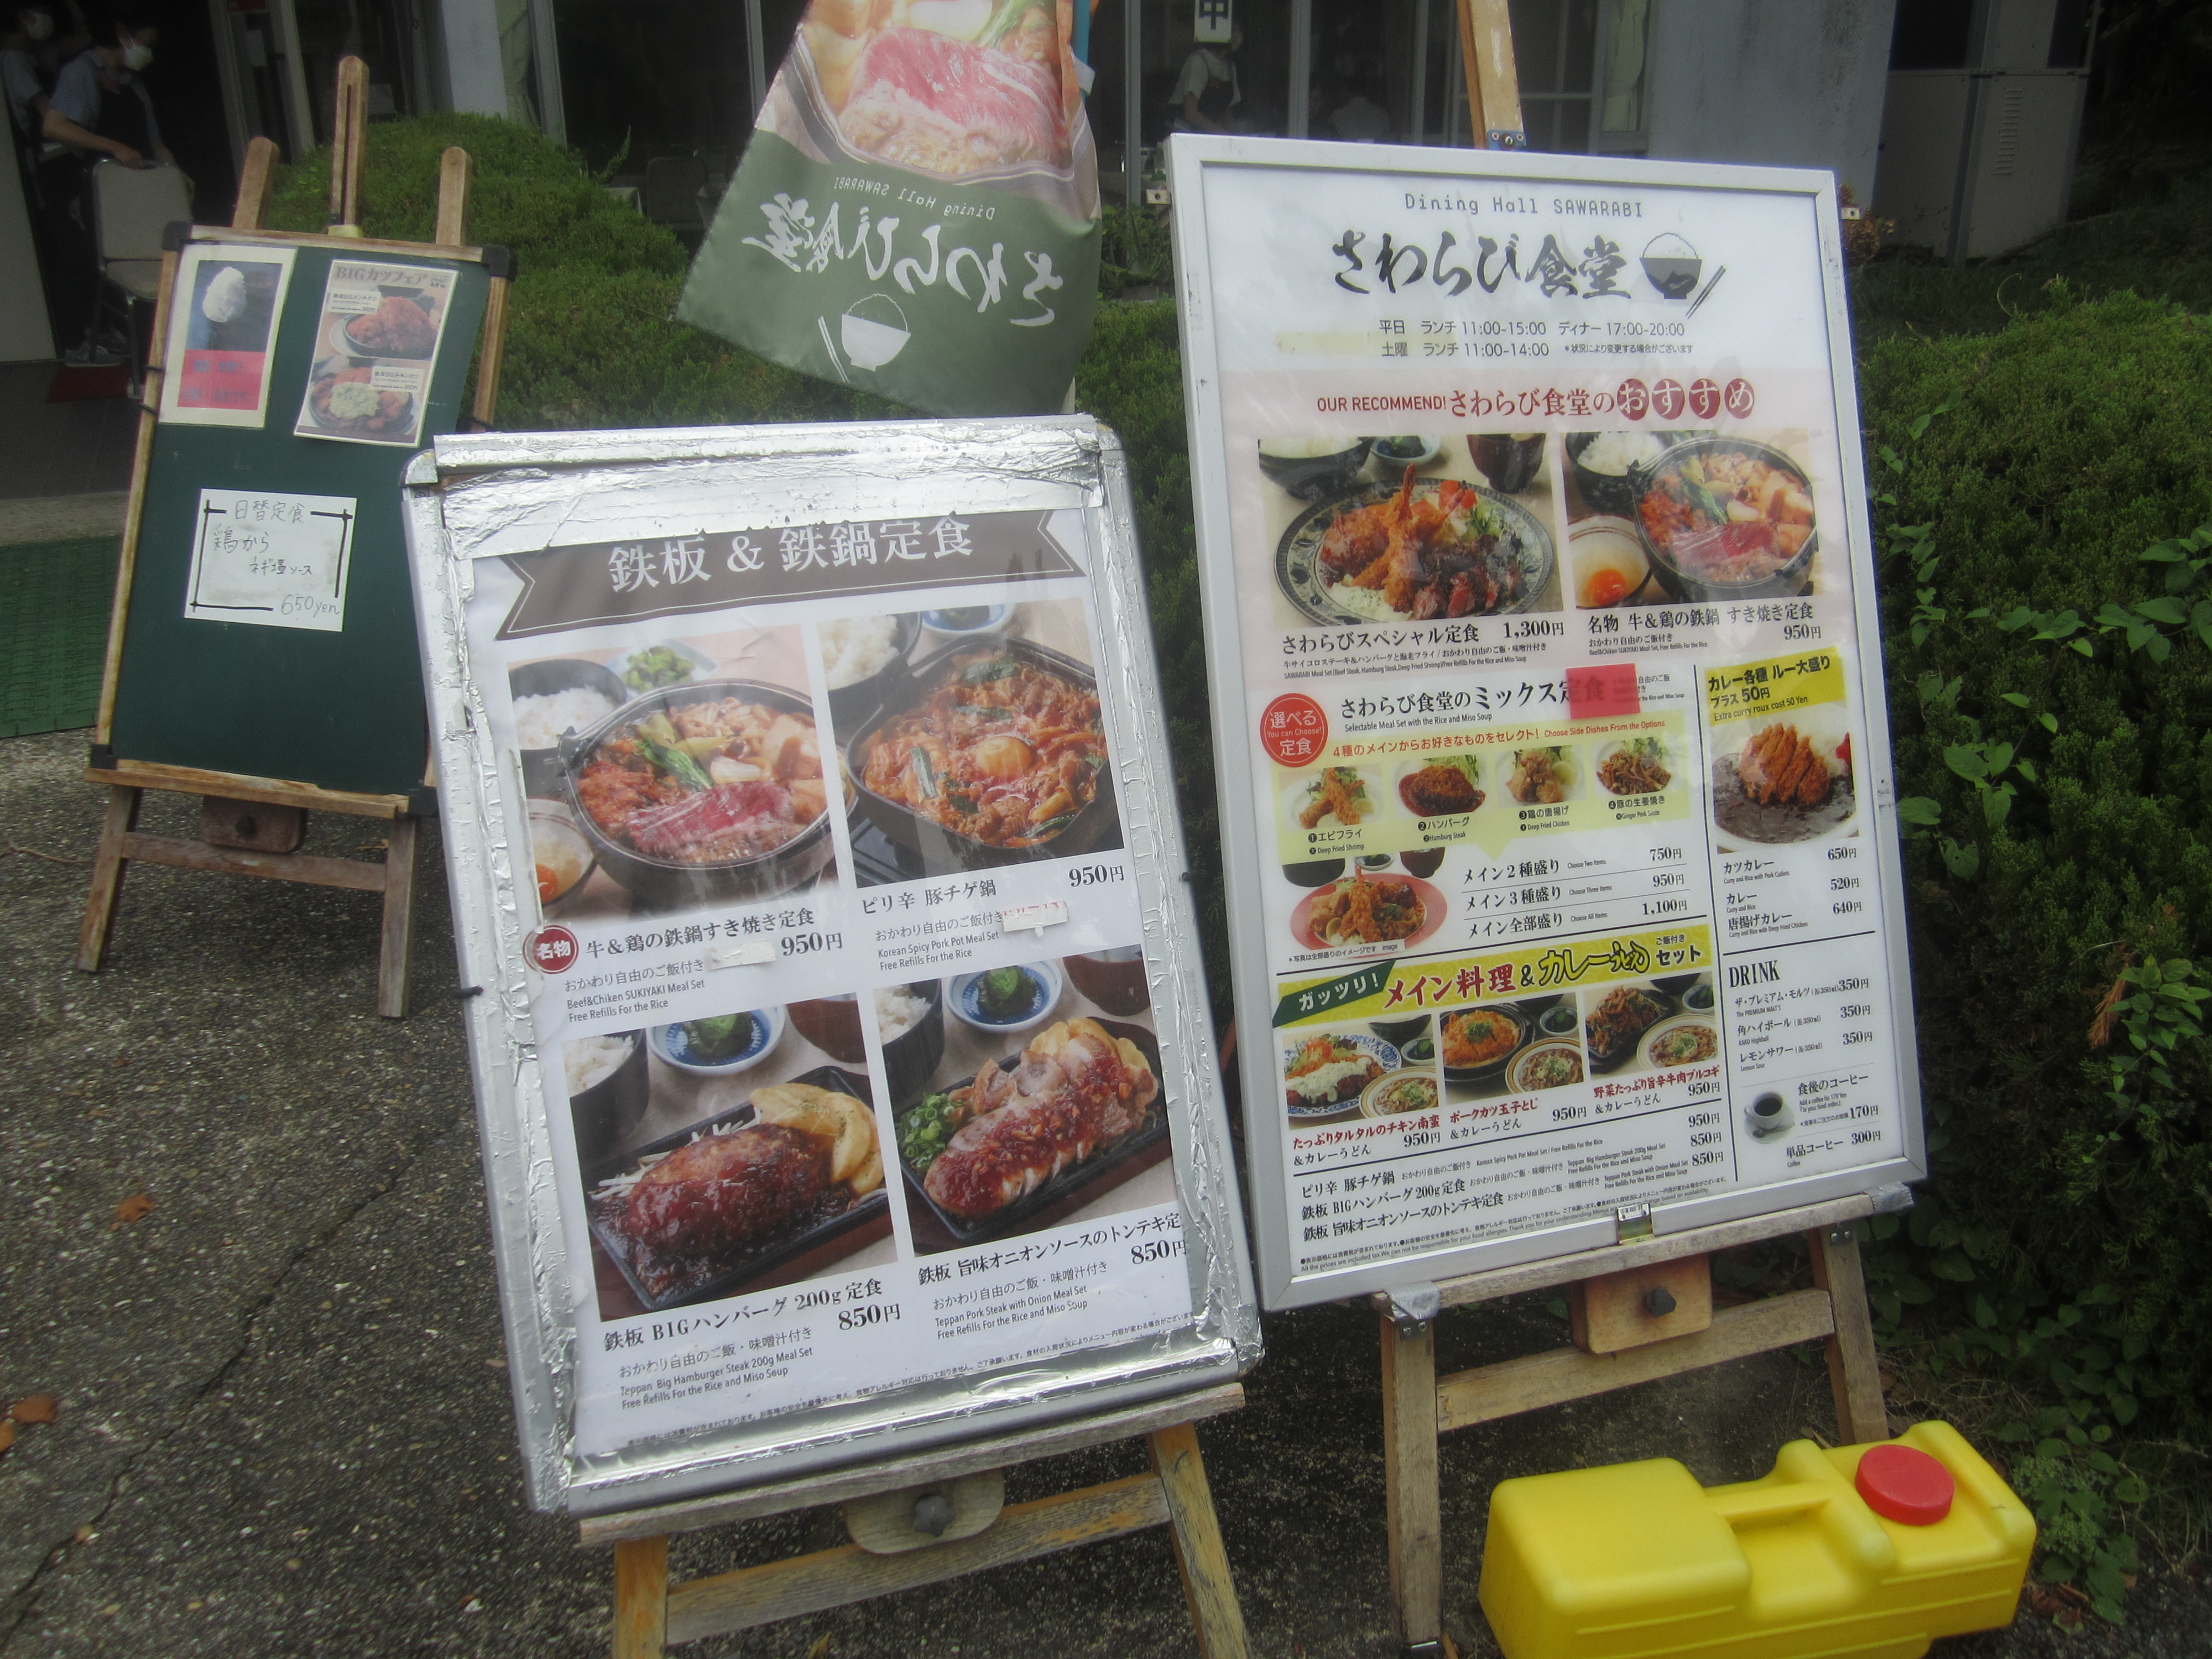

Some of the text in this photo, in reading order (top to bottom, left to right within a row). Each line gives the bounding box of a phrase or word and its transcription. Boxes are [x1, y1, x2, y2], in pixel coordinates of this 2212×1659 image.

[1405, 193, 1643, 218] Dining Hall SAWARABI
[1332, 229, 1632, 299] さわらび食堂
[1379, 320, 1405, 335] 平日
[1420, 320, 1457, 334] ランチ
[1558, 321, 1601, 335] ディナー
[1382, 342, 1408, 357] 土曜
[1423, 343, 1459, 357] ランチ
[1317, 396, 1348, 413] OUR
[1352, 395, 1447, 411] RECOMMEND!
[235, 499, 305, 524] 日替定食
[213, 524, 270, 554] 鶏から
[608, 515, 973, 593] 鉄板 & 鉄鍋定食
[1588, 602, 1813, 634] 名物 牛&鶏の鉄鍋 すき焼き定食
[1282, 624, 1480, 655] さわらびスペシャル定食
[1503, 620, 1564, 640] 1,300円
[1783, 623, 1821, 640] 950円
[1708, 655, 1831, 692] カレー各種 ルー大盛り
[1710, 686, 1771, 709] プラス 50円
[1714, 710, 1732, 722] Extra
[1733, 707, 1752, 720] curry
[1771, 700, 1786, 709] cost
[1787, 697, 1796, 707] 50
[1796, 695, 1808, 705] Yen
[1270, 709, 1317, 729] 選べる
[1344, 712, 1493, 732] Selectable Meal Set with the Rice and Miso Soup
[1295, 727, 1322, 735] Choose!
[1280, 738, 1312, 757] 定食
[1428, 816, 1470, 830] ハンバーグ
[1318, 828, 1362, 842] エビフライ
[1649, 847, 1682, 862] 750円
[1828, 847, 1857, 860] 650円
[1068, 864, 1125, 888] 950円
[1464, 859, 1559, 884] メイン2種盛り
[1724, 859, 1774, 874] カツカレー
[1652, 874, 1684, 888] 950円
[1830, 877, 1859, 890] 520円
[862, 879, 997, 915] ピリ辛 豚チゲ鍋
[1466, 886, 1561, 911] メイン3種盛り
[1726, 893, 1757, 905] カレー
[1642, 899, 1688, 916] 1,100円
[1833, 901, 1862, 914] 640円
[875, 911, 1002, 942] おかわり自由のご飯付き
[1469, 912, 1563, 939] メイン全部盛り
[1728, 912, 1792, 931] 唐揚げカレー
[586, 907, 815, 959] 牛&鶏の鉄鍋すき焼き定食
[1656, 935, 1685, 946] ご飯付き
[536, 940, 571, 961] 名物
[780, 932, 843, 957] 950円
[878, 930, 1000, 958] Korean Spicy Pork Pot Meal Set
[1656, 945, 1702, 966] セット
[564, 959, 704, 993] おかわり自由のご飯付き
[1729, 959, 1781, 988] DRINK
[567, 979, 705, 1010] Beef&Chiken SUKIYAKI Meal Set
[1384, 963, 1517, 1009] メイン料理
[1520, 964, 1535, 987] &
[1838, 978, 1869, 992] 350円
[1840, 1005, 1870, 1018] 350円
[1738, 1018, 1791, 1036] 角ハイボール
[1842, 1031, 1872, 1045] 350円
[1740, 1047, 1794, 1062] レモンサワー
[1688, 1081, 1720, 1097] 950円
[1798, 1074, 1869, 1096] 食後のコーヒー
[1450, 1097, 1538, 1124] ポークカツ玉子とじ
[1552, 1106, 1587, 1121] 950円
[1688, 1113, 1720, 1128] 950円
[1849, 1105, 1879, 1119] 170円
[1404, 1132, 1441, 1148] 950円
[1691, 1132, 1722, 1147] 850円
[1851, 1130, 1881, 1145] 300円
[1692, 1151, 1724, 1167] 850円
[1786, 1140, 1843, 1159] 単品コーヒー
[1302, 1171, 1395, 1198] ピリ辛 豚チゲ鍋
[1302, 1203, 1328, 1220] 鉄板
[1416, 1184, 1440, 1200] 200g
[1442, 1178, 1465, 1194] 定食
[1303, 1224, 1328, 1242] 鉄板
[1131, 1239, 1187, 1265] 850円
[917, 1262, 952, 1286] 鉄板
[604, 1327, 644, 1353] 鉄板
[794, 1289, 842, 1312] 200g
[846, 1277, 883, 1302] 定食
[838, 1302, 901, 1331] 850円
[620, 1347, 813, 1399] Teppan Big Hamburger Steak 200g Meal Set
